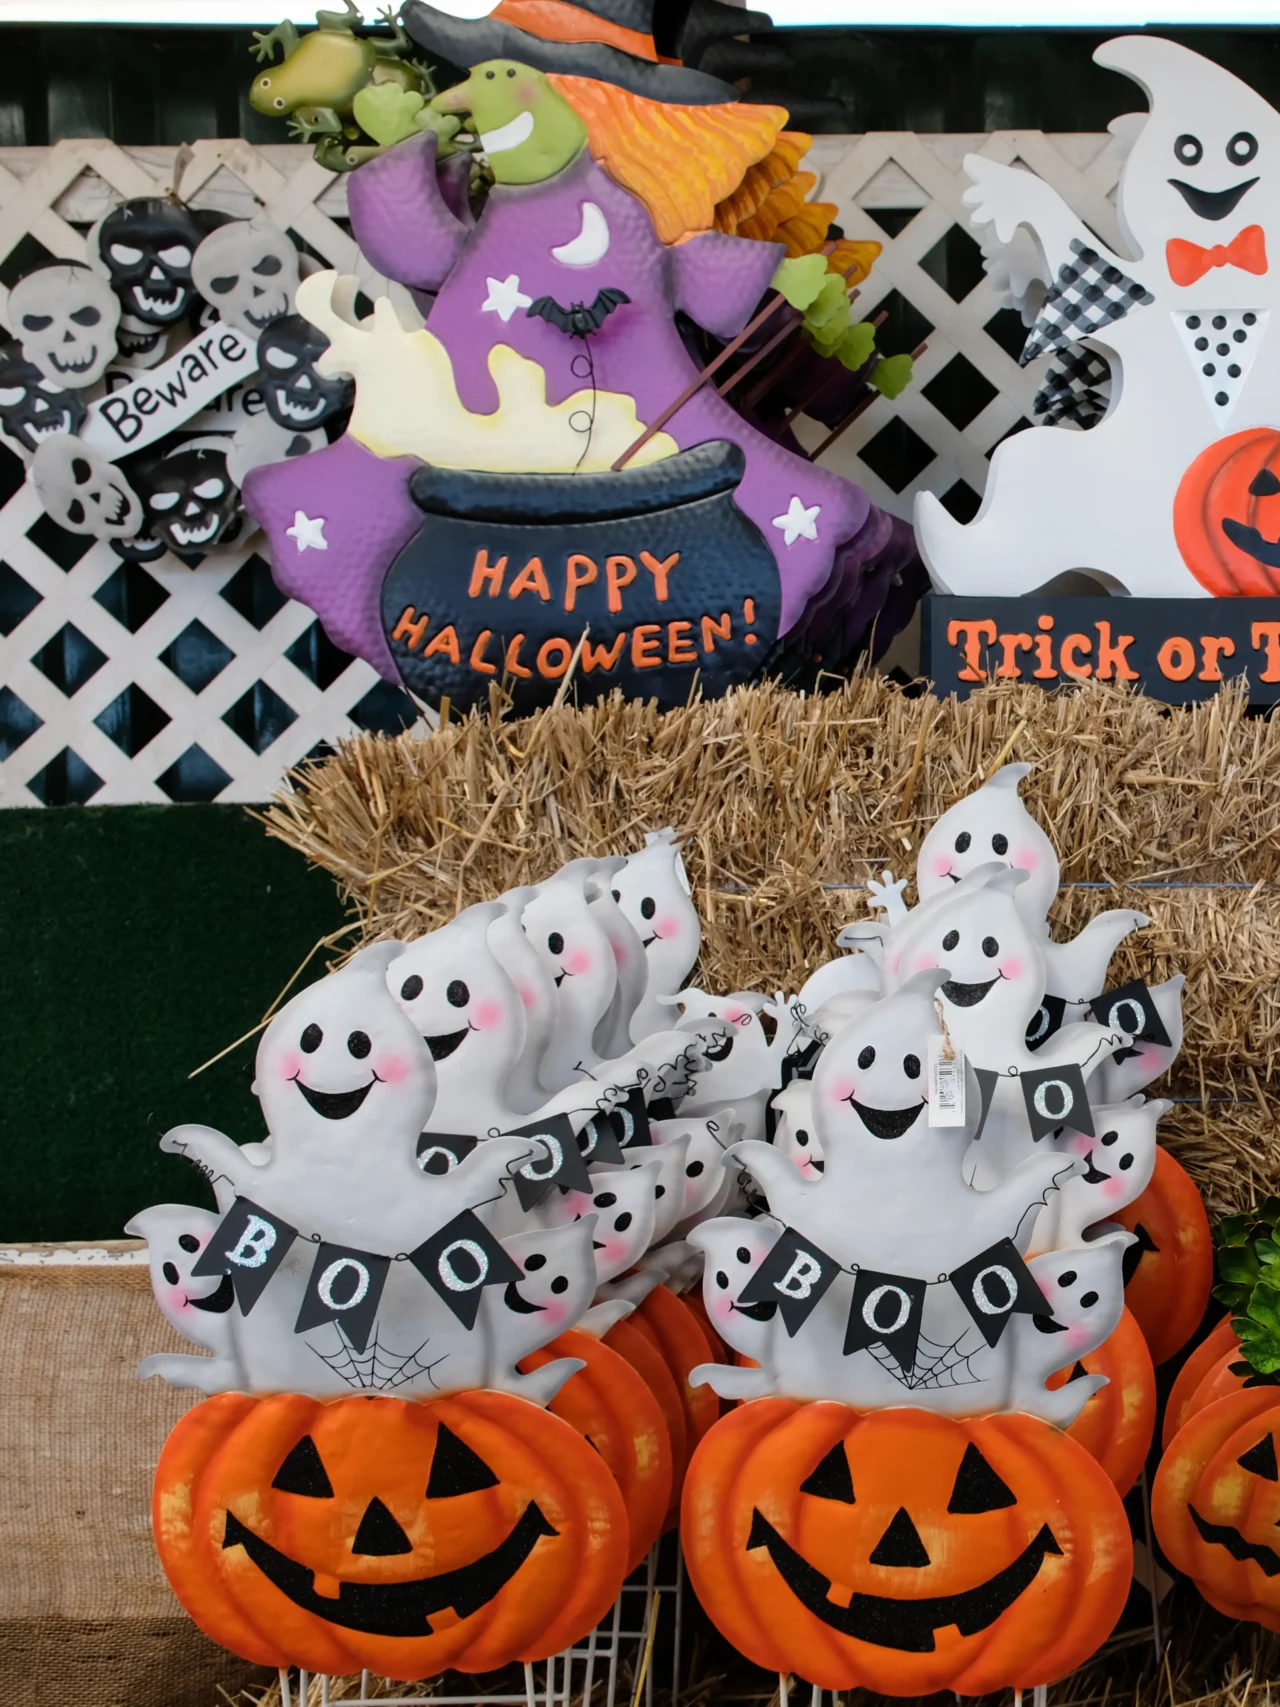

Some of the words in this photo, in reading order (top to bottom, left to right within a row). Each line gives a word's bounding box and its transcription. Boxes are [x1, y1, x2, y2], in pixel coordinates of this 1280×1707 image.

[98, 333, 247, 443] Beware
[468, 549, 681, 613] HAPPY
[392, 598, 758, 679] HALLOWEEN!
[947, 615, 1140, 682] Trick
[1157, 635, 1235, 682] or
[225, 1214, 489, 1310] BOO
[773, 1249, 1018, 1334] BOO
